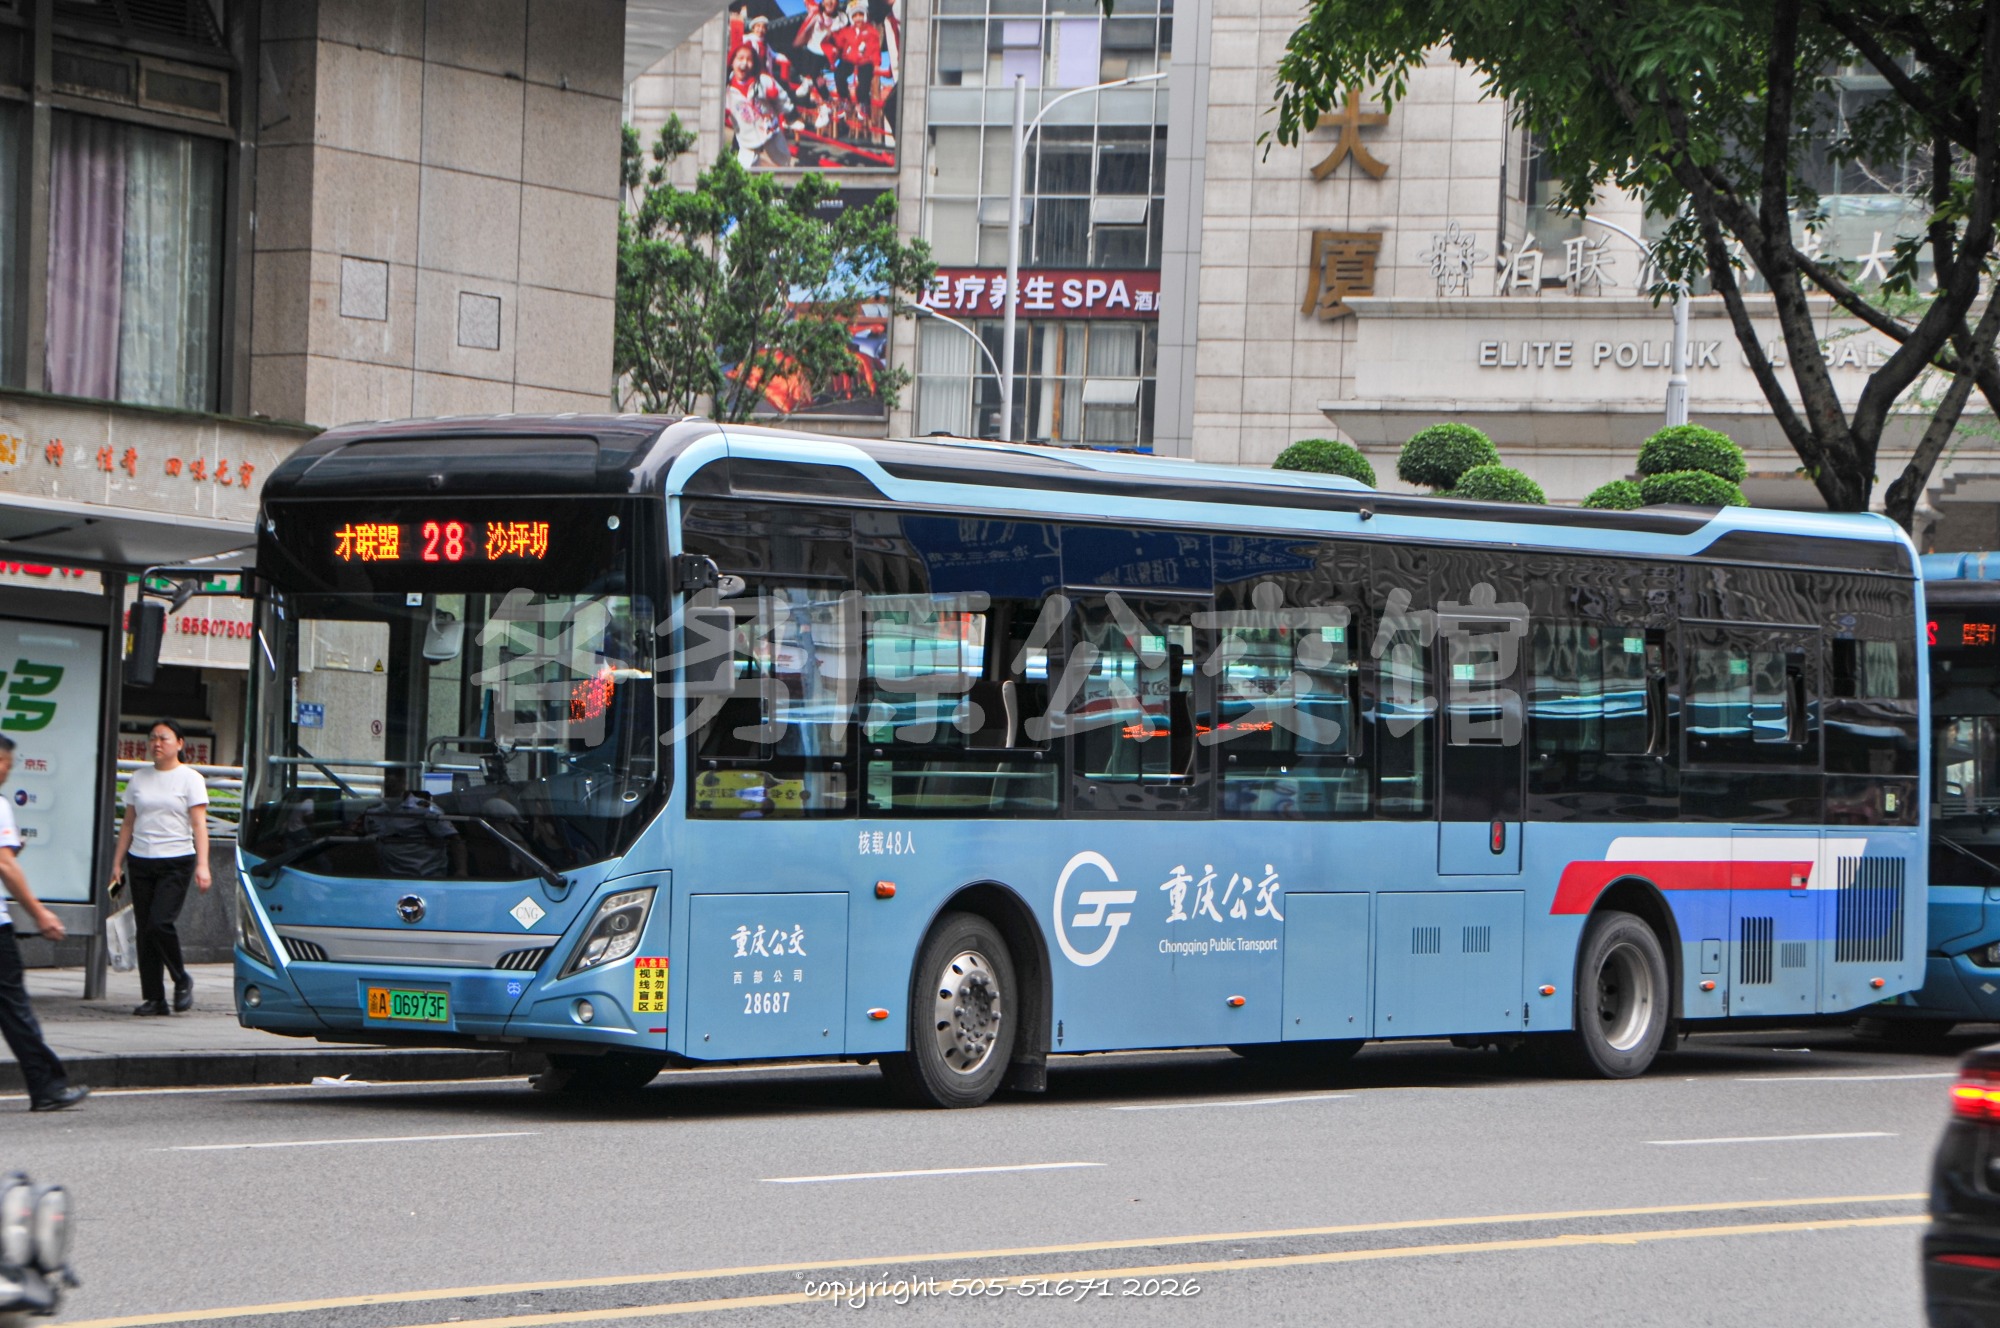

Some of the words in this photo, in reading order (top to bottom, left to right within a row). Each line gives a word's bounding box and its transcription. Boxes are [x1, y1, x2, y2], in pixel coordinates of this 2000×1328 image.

[1061, 278, 1131, 309] SPA
[1479, 341, 1573, 368] ELITE
[335, 523, 400, 561] 才联盟
[423, 522, 463, 560] 28
[485, 521, 549, 560] 沙坪坝
[858, 830, 915, 855] 核载48人
[1159, 863, 1285, 924] 重庆公交
[515, 906, 540, 920] CNG
[731, 924, 807, 958] 重庆公交
[1159, 938, 1208, 956] Chongqing
[1209, 937, 1236, 952] Public
[1237, 937, 1278, 954] Transport
[638, 968, 651, 1011] 视线盲区
[733, 969, 803, 985] 西部公司
[744, 992, 790, 1014] 28687
